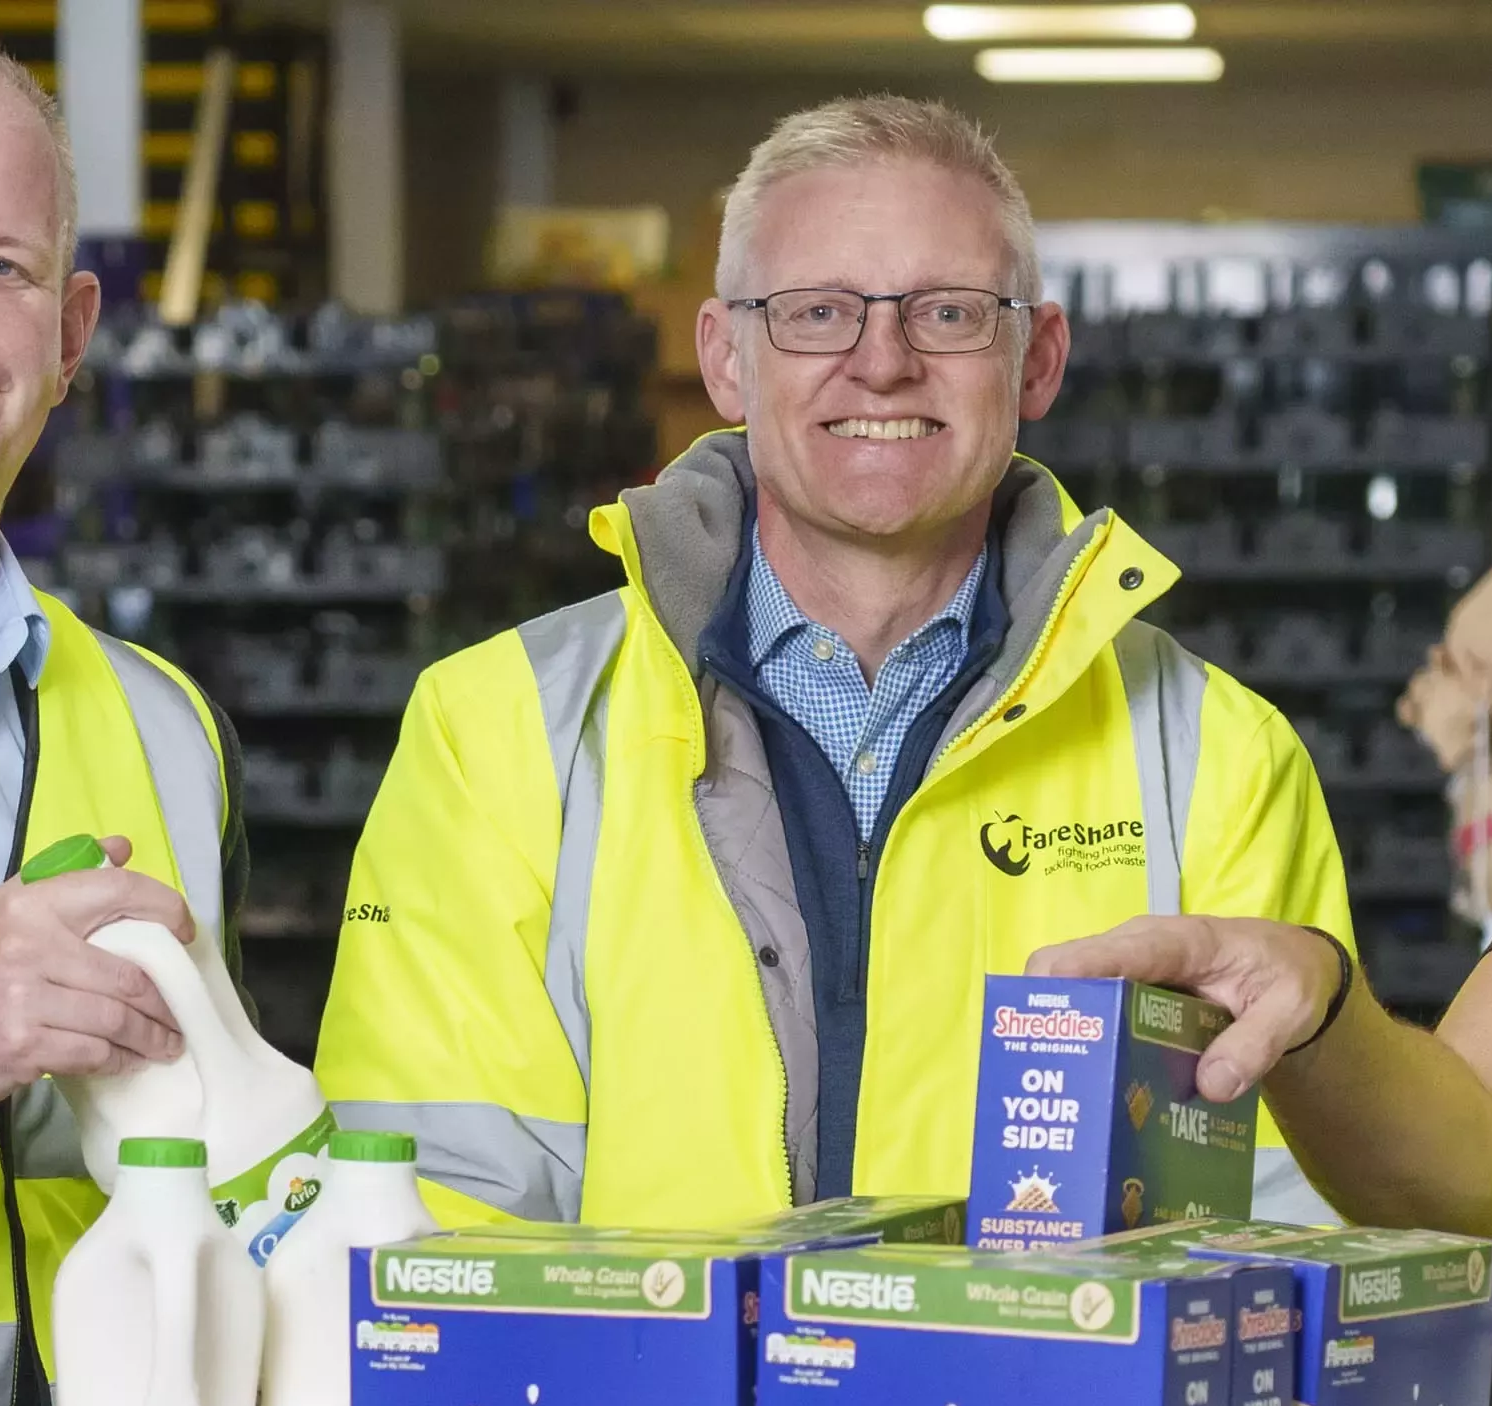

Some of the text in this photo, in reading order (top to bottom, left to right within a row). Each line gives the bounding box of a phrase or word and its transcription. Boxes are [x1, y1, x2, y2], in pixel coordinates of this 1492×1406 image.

[1022, 819, 1144, 849] FareShare
[1057, 842, 1145, 861] fighting hunger,
[1044, 855, 1146, 877] tackling food waste
[994, 1006, 1103, 1041] Shreddies
[1004, 1041, 1089, 1056] THE ORIGINAL
[1022, 1069, 1064, 1094] ON
[1002, 1097, 1080, 1123] YOUR
[1169, 1101, 1209, 1145] TAKE
[1002, 1125, 1075, 1152] SIDE!
[291, 1181, 318, 1210] Arla
[980, 1217, 1084, 1239] SUBSTANCE
[386, 1256, 640, 1296] Nestlé Whole Grain
[801, 1268, 1068, 1312] Nestlé Whole Grain
[1185, 1380, 1209, 1406] ON
[1252, 1367, 1275, 1394] ON
